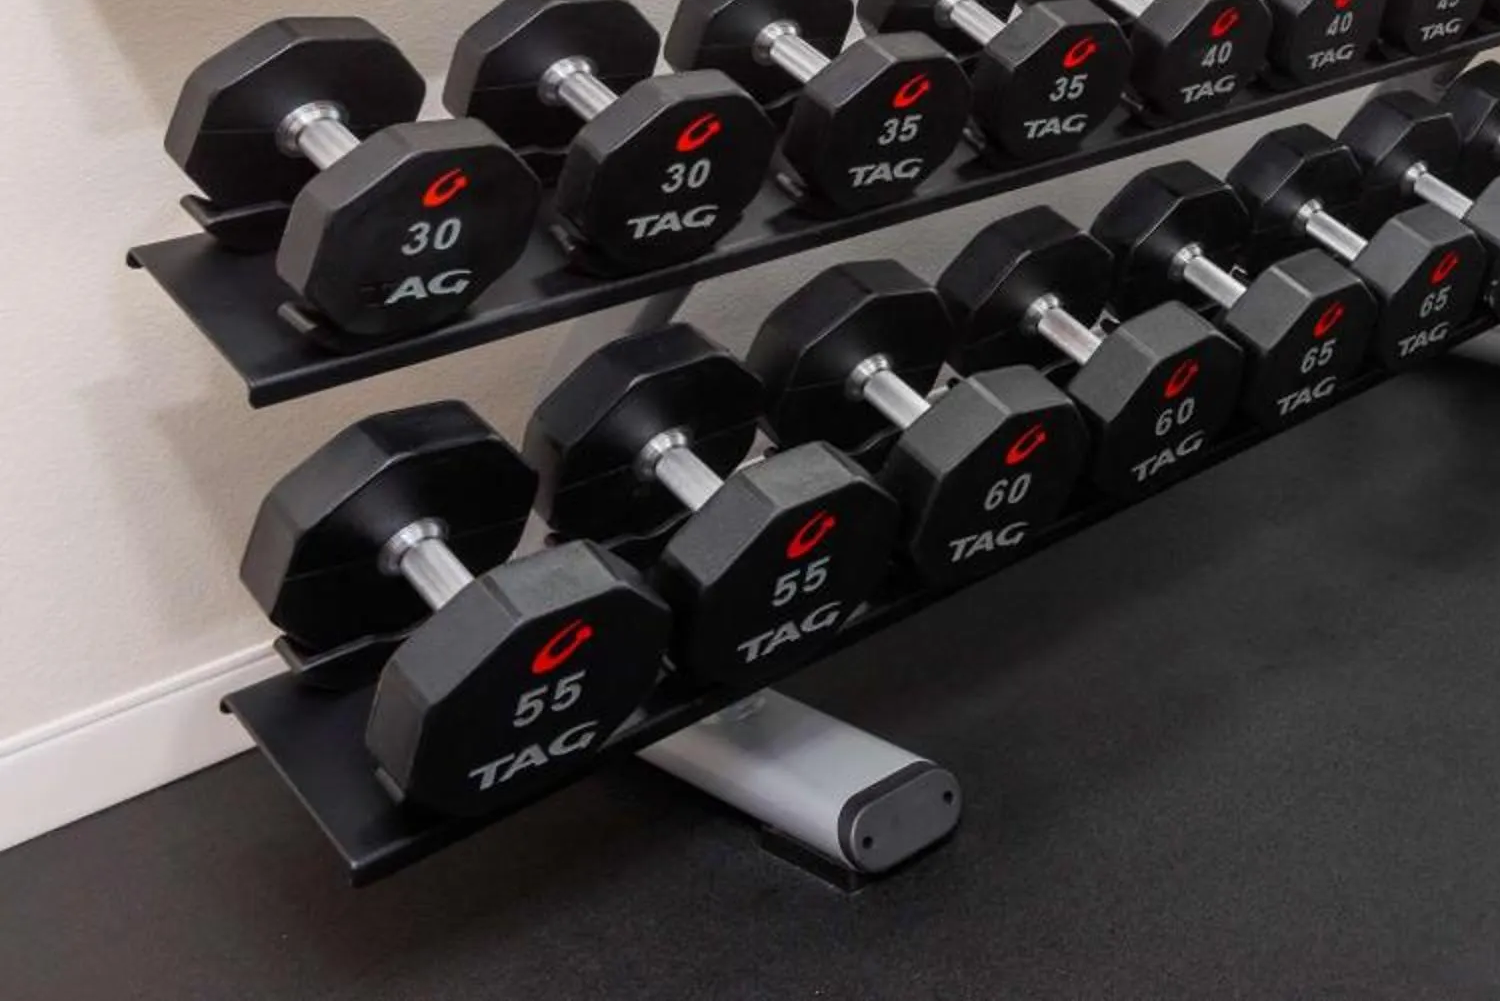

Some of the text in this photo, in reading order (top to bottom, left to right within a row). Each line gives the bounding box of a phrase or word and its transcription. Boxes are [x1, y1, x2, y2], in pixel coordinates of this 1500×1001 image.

[1325, 12, 1354, 36] 40
[1420, 17, 1462, 41] TAG
[1200, 40, 1233, 68] 40
[1308, 43, 1355, 70] TAG
[1049, 73, 1089, 102] 35
[1180, 74, 1236, 104] TAG
[877, 114, 922, 146] 35
[1023, 113, 1088, 139] TAG
[661, 158, 711, 194] 30
[848, 157, 924, 190] TAG
[401, 217, 462, 256] 30
[626, 204, 718, 240] TAG
[1419, 284, 1451, 318] 65
[1300, 338, 1336, 374] 65
[1397, 321, 1449, 357] TAG
[1276, 375, 1337, 416] TAG
[1154, 397, 1196, 439] 60
[1131, 430, 1203, 482] TAG
[984, 473, 1032, 511] 60
[948, 521, 1028, 563] TAG
[772, 555, 833, 609] 55
[737, 600, 841, 663] TAG
[512, 670, 584, 732] 55
[468, 718, 598, 791] TAG
